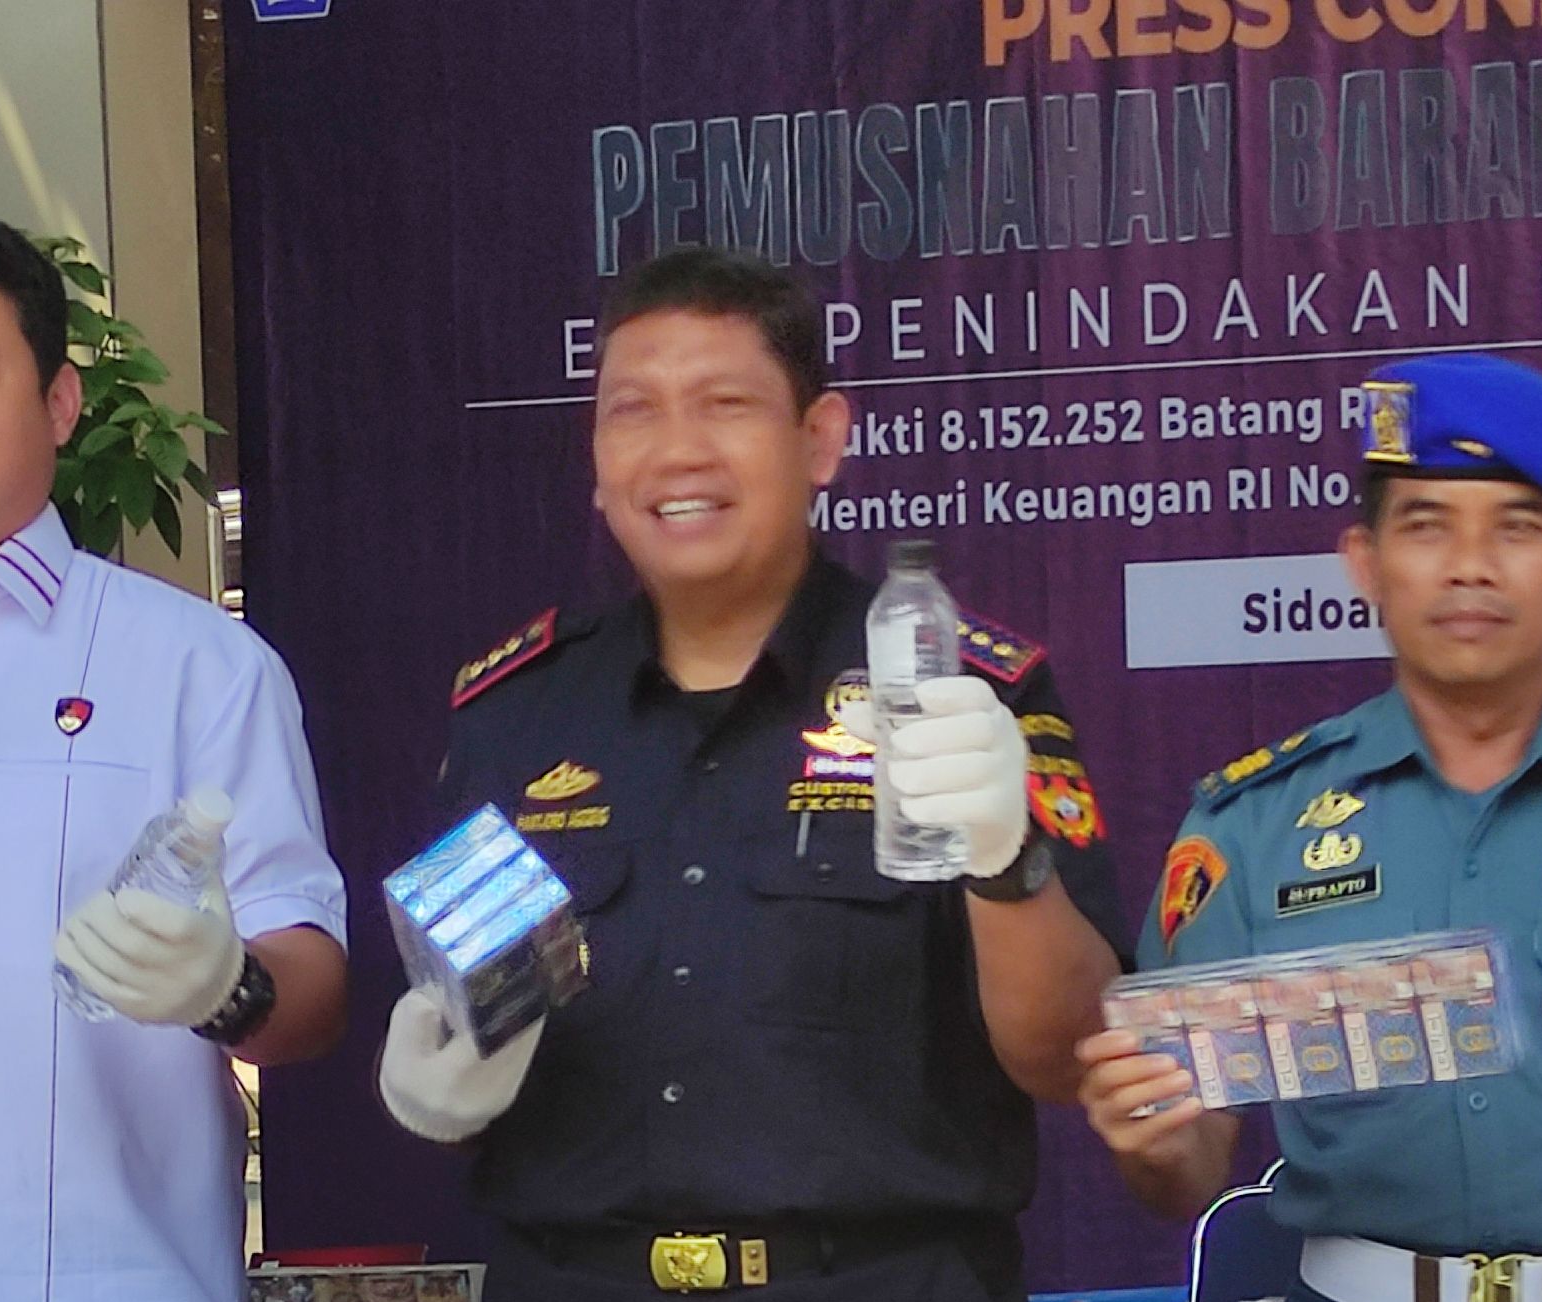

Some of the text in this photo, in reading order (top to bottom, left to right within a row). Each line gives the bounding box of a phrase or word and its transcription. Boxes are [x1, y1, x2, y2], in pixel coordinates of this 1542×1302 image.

[826, 265, 1470, 365] PENINDAKAN
[843, 407, 926, 457] ukti
[940, 398, 1145, 452] 8.152.252
[1160, 396, 1323, 445] Batang
[984, 477, 1211, 527] Keuangan
[1228, 469, 1272, 511] RI
[1288, 464, 1362, 506] No.
